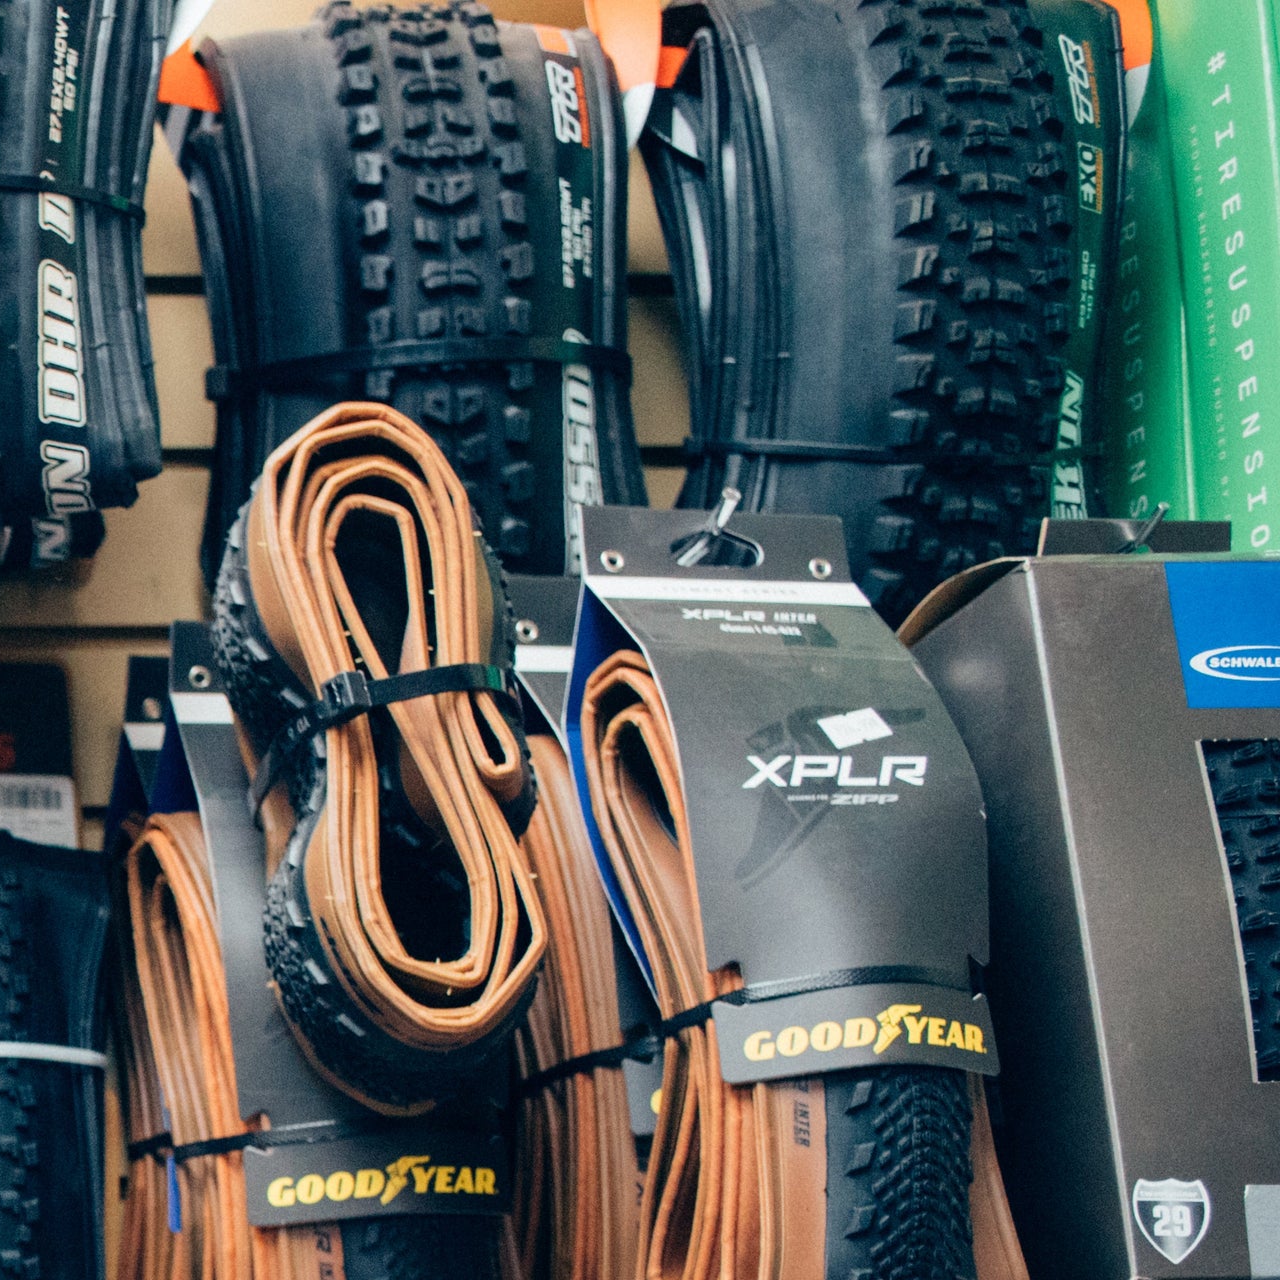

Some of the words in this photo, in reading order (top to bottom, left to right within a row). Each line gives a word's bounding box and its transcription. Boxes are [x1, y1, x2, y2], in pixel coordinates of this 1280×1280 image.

[38, 258, 87, 428] DHR
[681, 607, 766, 622] XPLR
[741, 754, 928, 789] XPLR
[830, 792, 900, 806] ZIPP
[743, 1004, 987, 1061] GOODYEAR
[1152, 1205, 1192, 1237] 29
